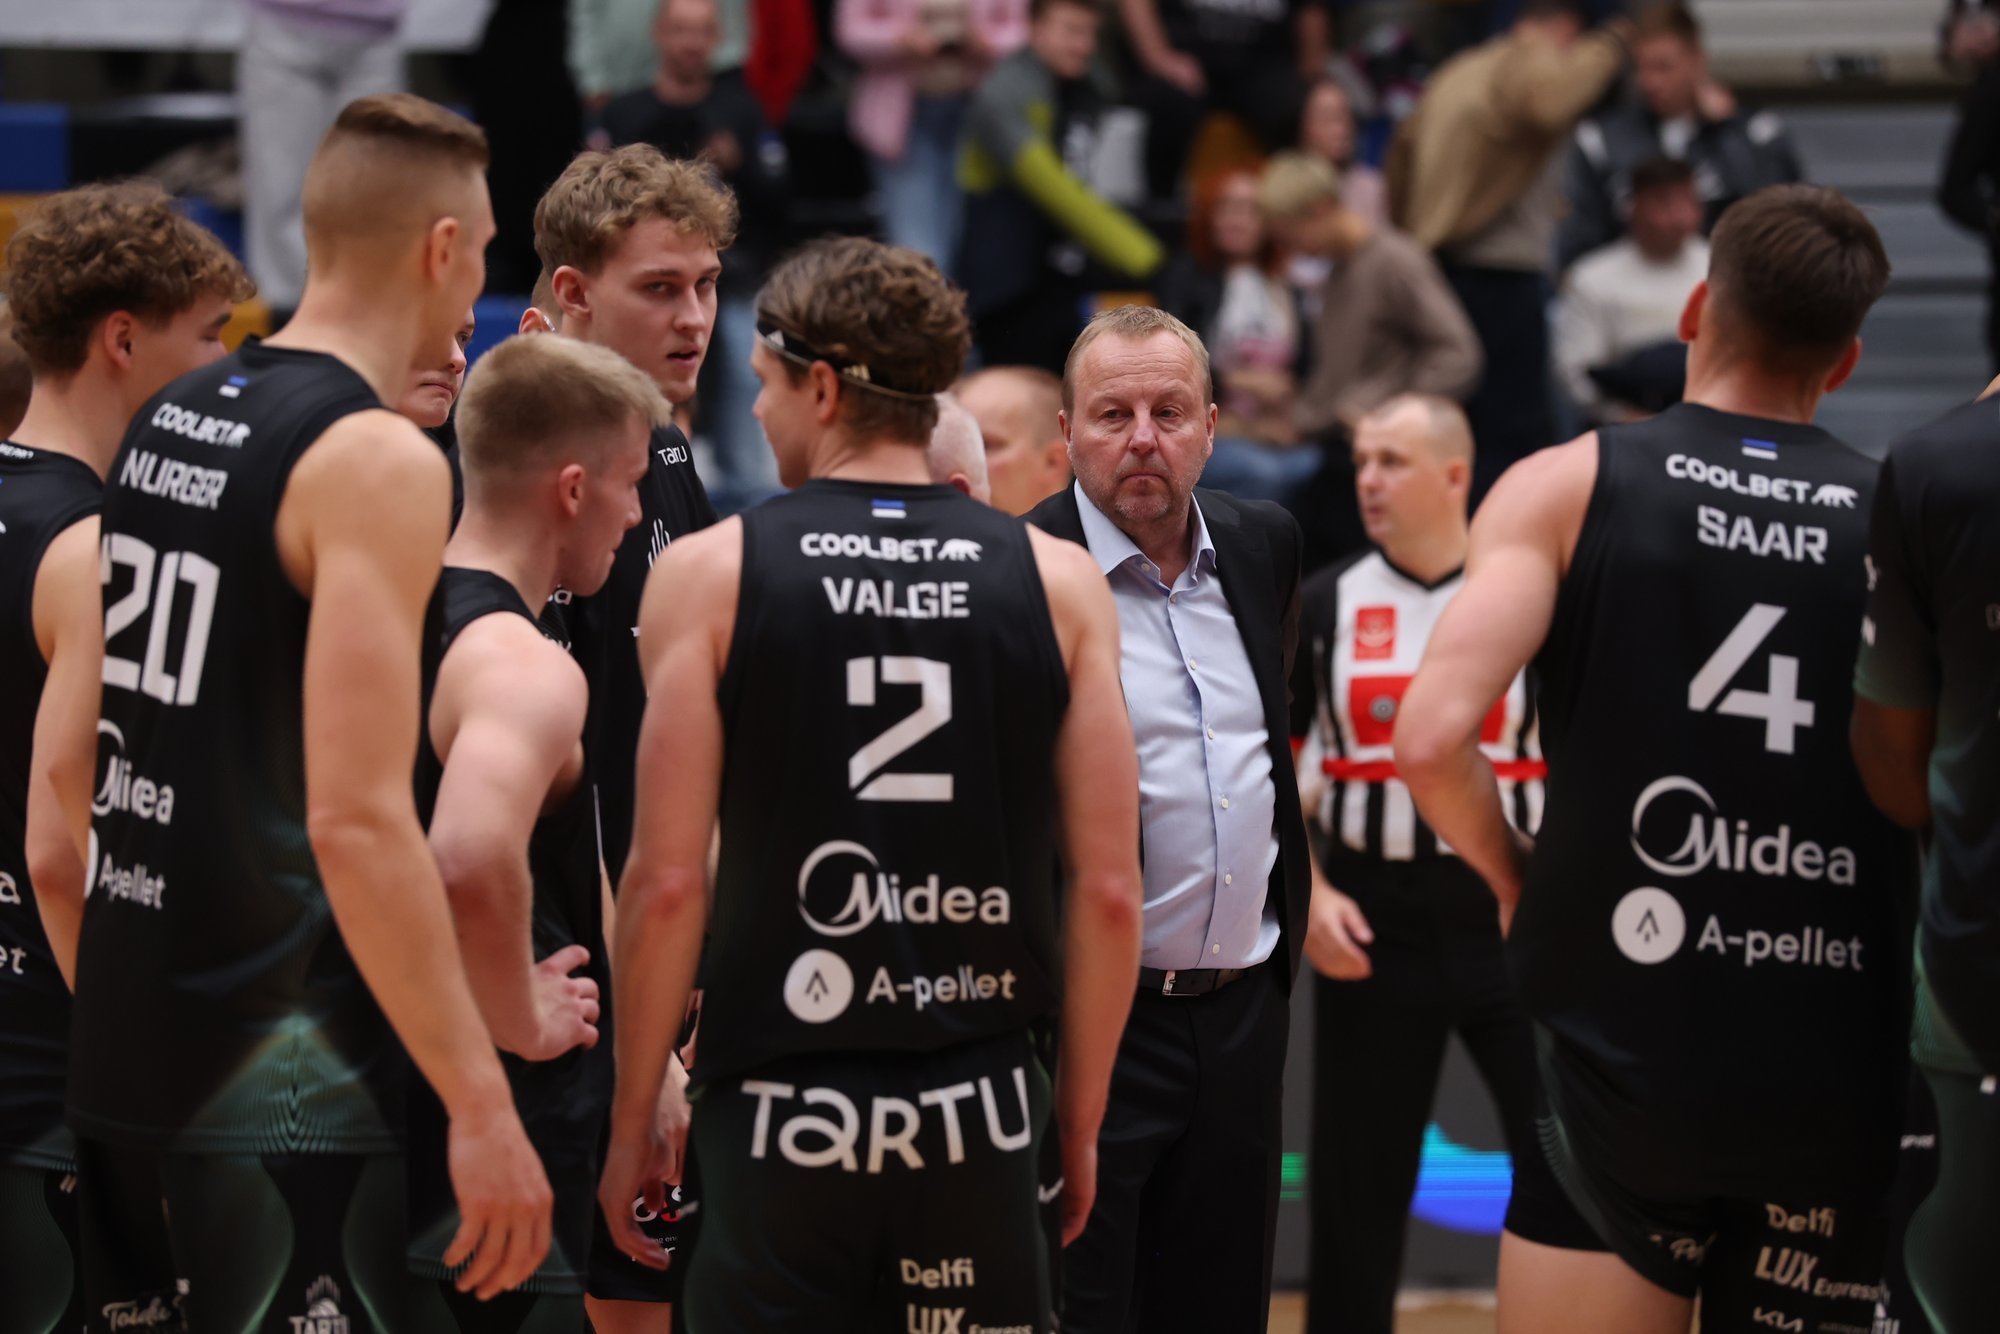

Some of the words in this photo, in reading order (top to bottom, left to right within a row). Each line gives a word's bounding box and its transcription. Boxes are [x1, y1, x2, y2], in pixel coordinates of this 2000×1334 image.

[151, 402, 232, 446] COOLBET
[119, 448, 228, 511] NURGER
[1665, 453, 1812, 504] COOLBET
[800, 532, 938, 562] COOLBET
[1697, 504, 1828, 565] SAAR
[101, 532, 221, 706] 20
[822, 577, 970, 619] VALGE
[1687, 602, 1815, 755] 4
[846, 655, 954, 802] 2
[1630, 775, 1857, 886] Midea
[797, 839, 1011, 937] Midea
[1696, 914, 1863, 971] A-pellet
[866, 965, 1017, 1011] A-pellet
[1765, 1203, 1837, 1238] Delfi
[900, 1257, 975, 1289] Delfi
[1754, 1246, 1818, 1292] LUX
[906, 1303, 967, 1334] LUX
